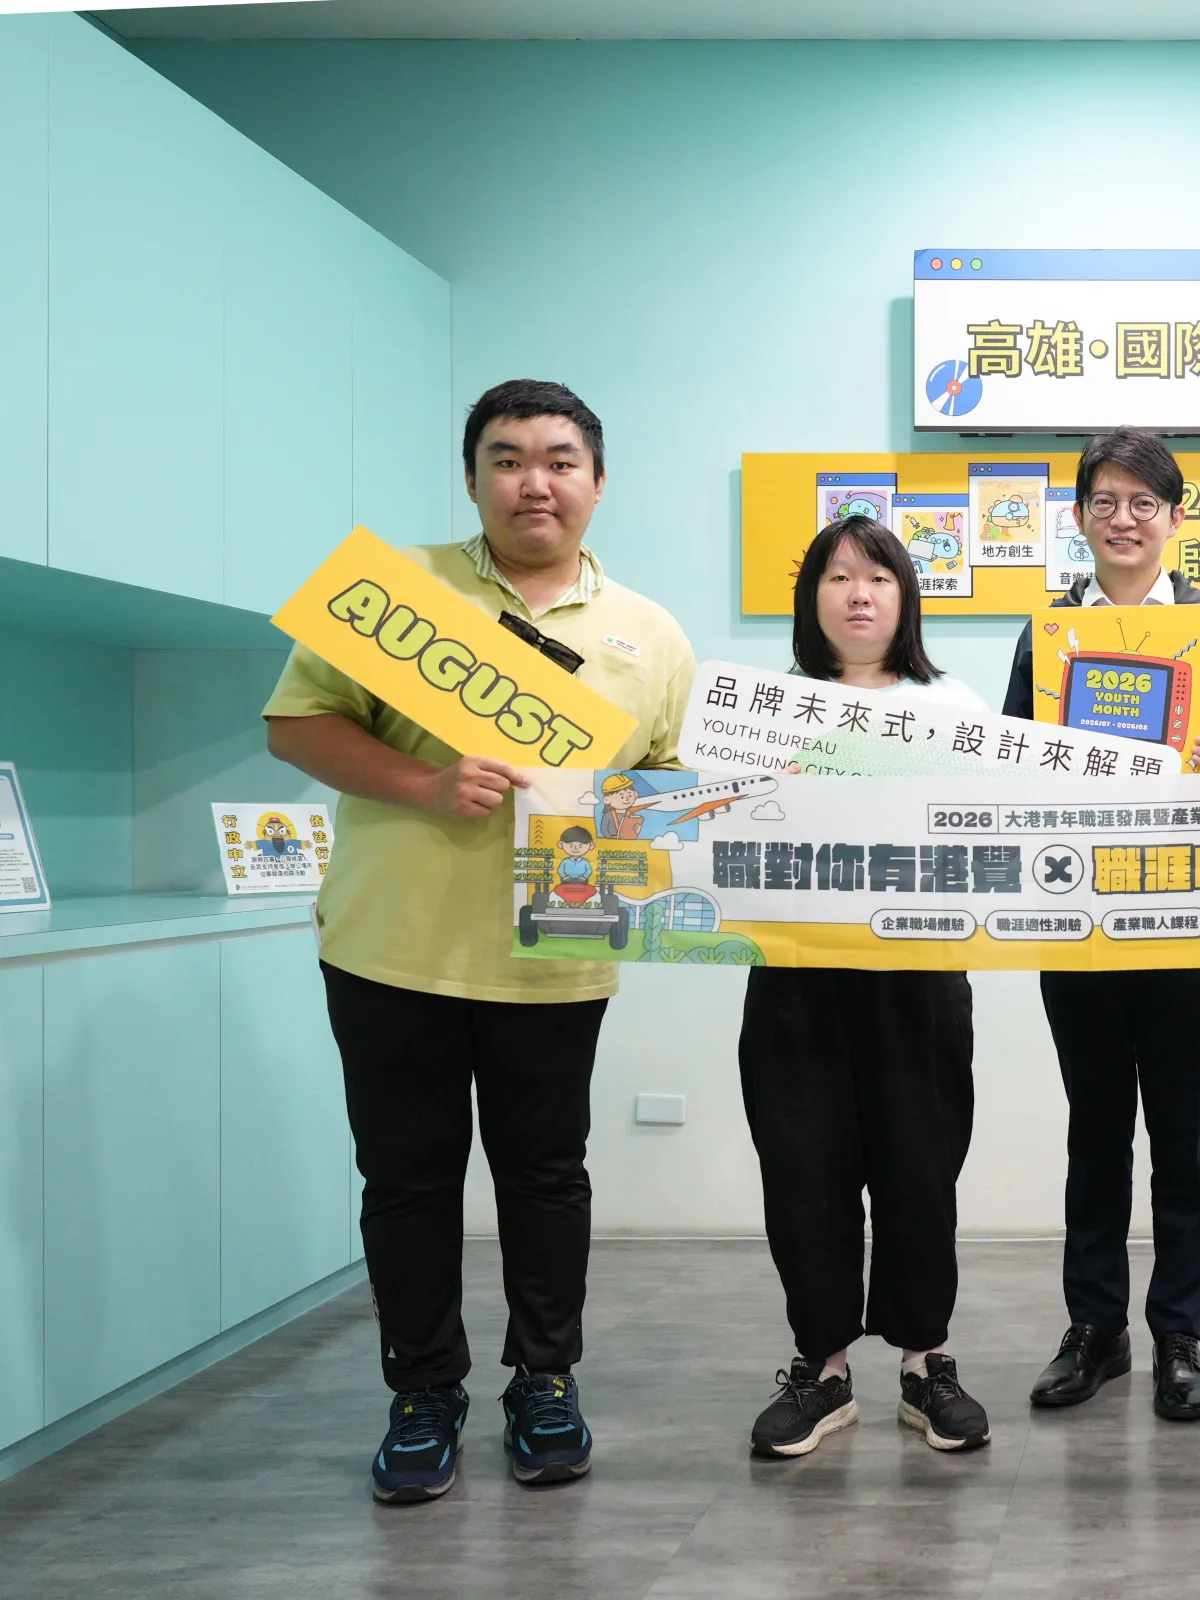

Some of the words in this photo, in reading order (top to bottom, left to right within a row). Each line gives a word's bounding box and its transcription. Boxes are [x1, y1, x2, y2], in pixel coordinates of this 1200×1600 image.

[981, 545, 1034, 558] 地方創生
[918, 578, 958, 591] 涯探索
[327, 578, 593, 767] AUGUST
[1086, 669, 1152, 693] 2026
[1095, 691, 1140, 704] YOUTH
[1092, 704, 1140, 717] MONTH
[1080, 718, 1111, 728] 2026/07
[1116, 721, 1148, 731] 2026/08
[702, 717, 761, 741] YOUTH
[766, 730, 837, 755] BUREAU
[933, 811, 993, 828] 2026
[221, 815, 247, 878] 行政中立
[881, 916, 965, 932] 企業職場體驗
[996, 918, 1082, 932] 職涯適性測驗
[1113, 916, 1199, 931] 產業職人課程
